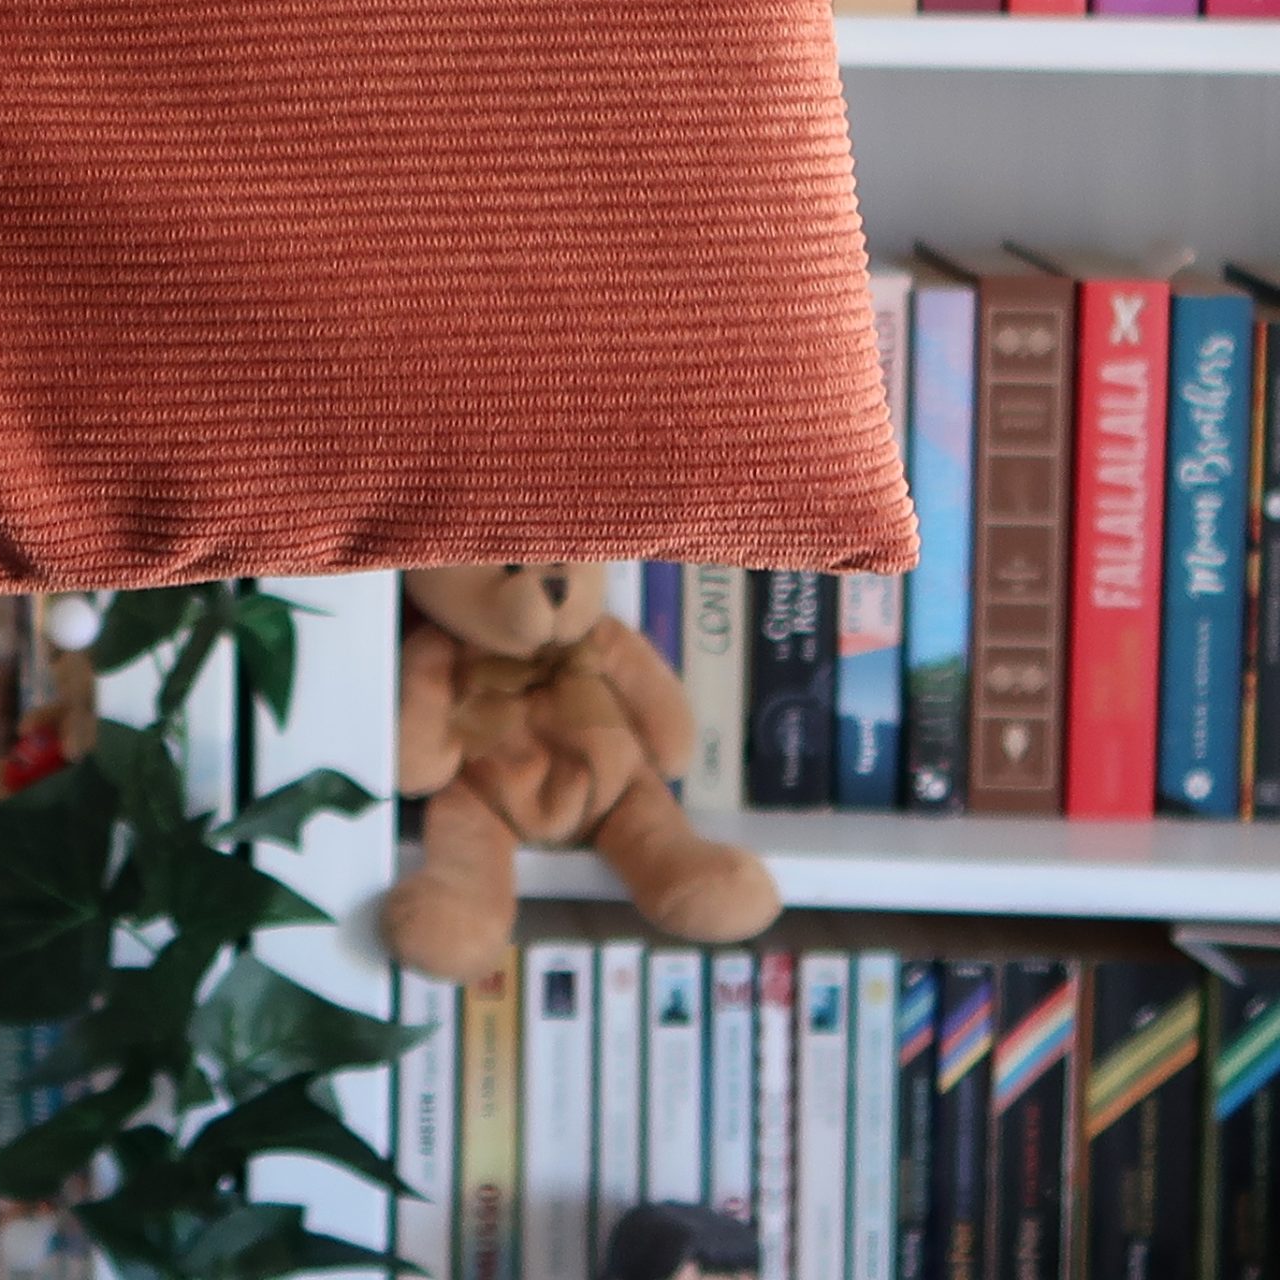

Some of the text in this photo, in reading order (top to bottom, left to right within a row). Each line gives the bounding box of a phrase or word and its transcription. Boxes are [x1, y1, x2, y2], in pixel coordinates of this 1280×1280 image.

[1183, 490, 1227, 599] Moon
[761, 572, 800, 641] Cirqu
[793, 572, 819, 634] Rêve
